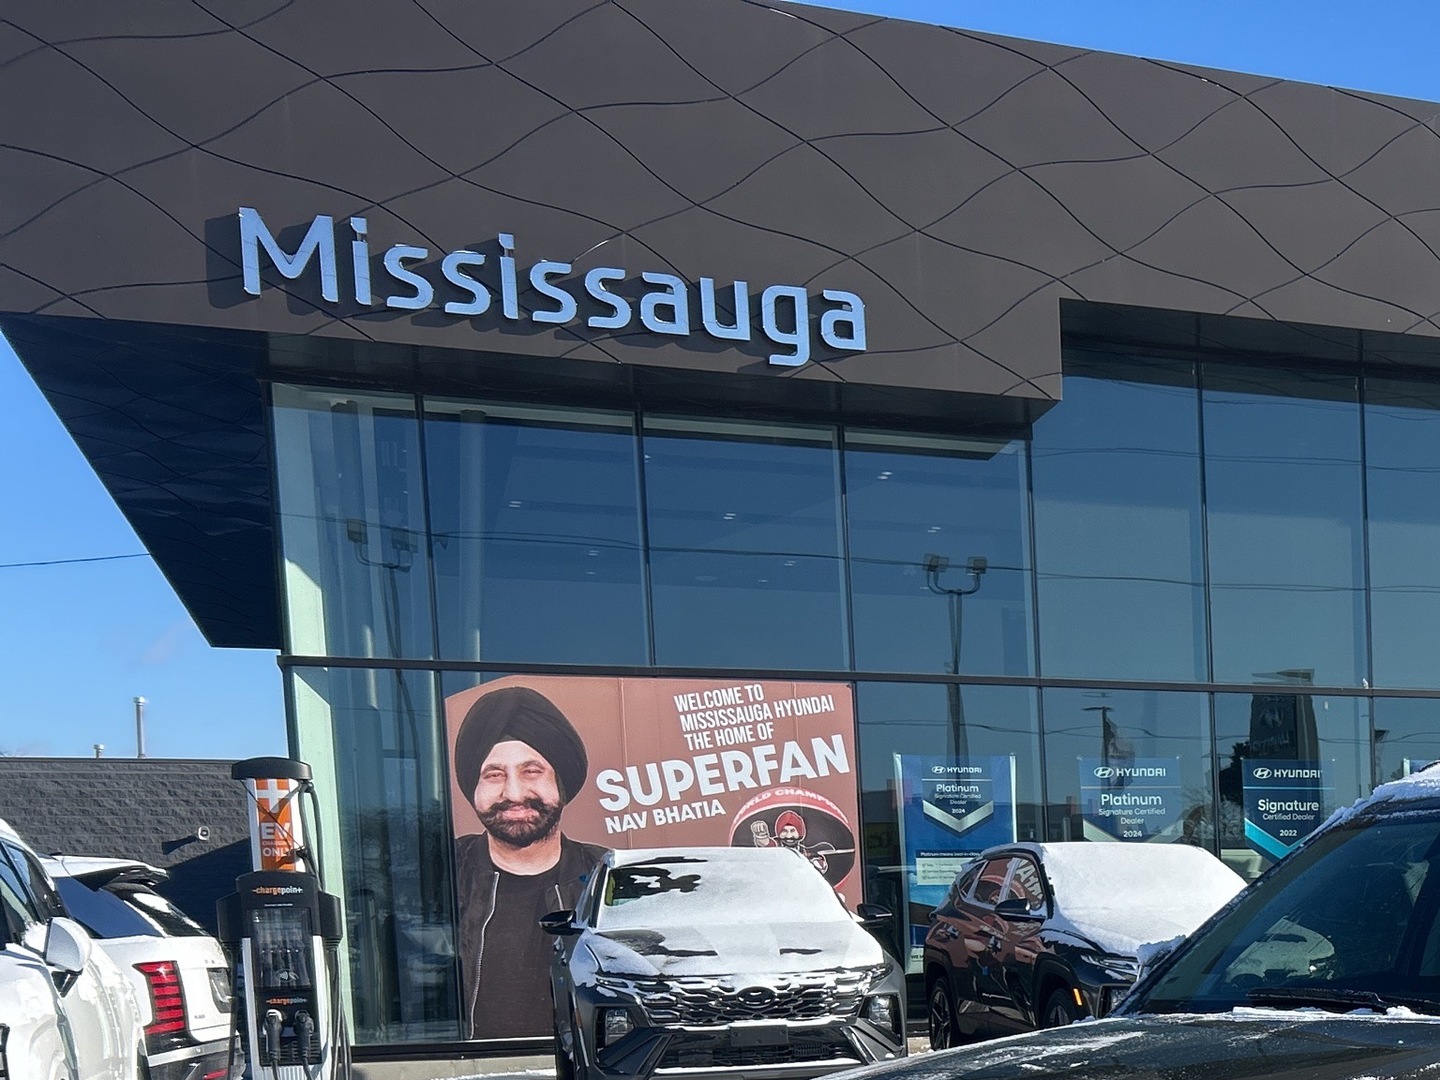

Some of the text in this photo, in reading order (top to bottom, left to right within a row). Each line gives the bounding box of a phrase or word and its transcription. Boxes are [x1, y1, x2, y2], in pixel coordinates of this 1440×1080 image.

[238, 206, 867, 367] Mississauga
[673, 683, 765, 713] WELCOME TO
[679, 694, 835, 732] MISSISSAUGA HYUNDAI
[684, 722, 775, 751] THE HOME OF
[596, 733, 850, 812] SUPERFAN
[1116, 768, 1166, 777] HYUNDAI
[1274, 769, 1321, 778] HYUNDAI
[936, 784, 979, 792] Platinum
[1101, 793, 1162, 805] Platinum
[1258, 799, 1319, 813] Signature
[604, 799, 727, 835] NAV BHATIA
[1098, 808, 1133, 817] Signature
[1120, 817, 1145, 825] Dealer
[261, 822, 291, 840] EV
[1123, 830, 1143, 838] 2024
[1279, 829, 1298, 837] 2022
[262, 847, 291, 858] ONLY
